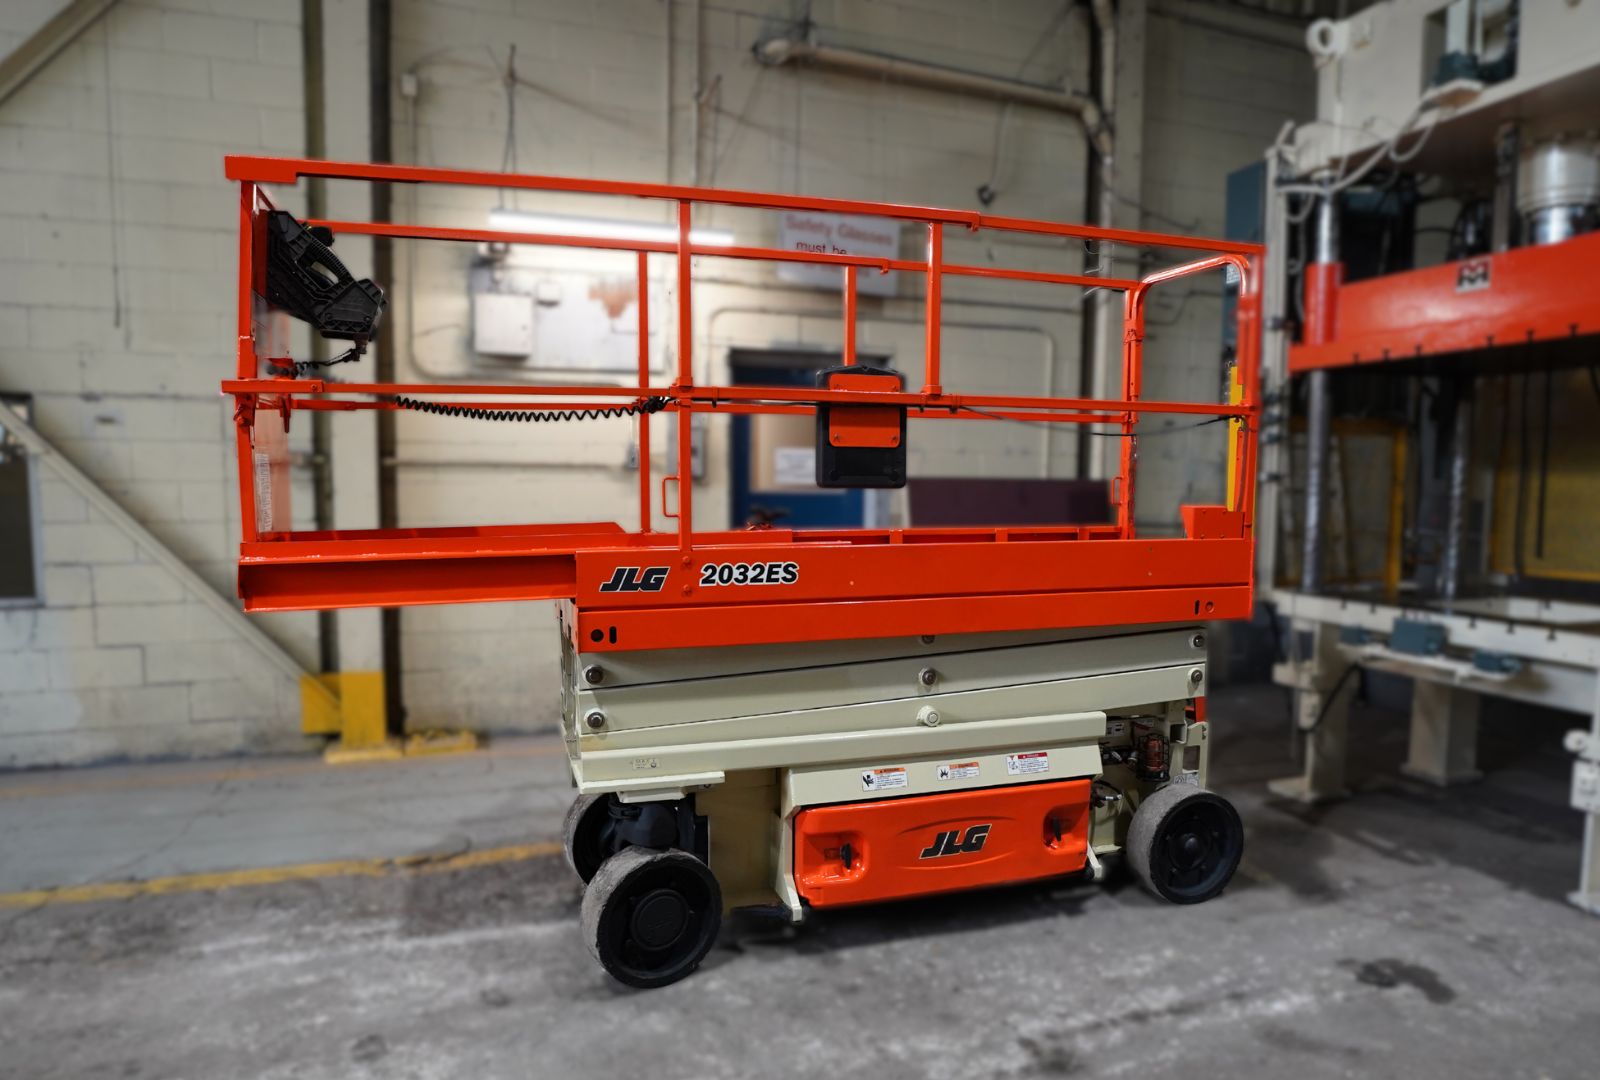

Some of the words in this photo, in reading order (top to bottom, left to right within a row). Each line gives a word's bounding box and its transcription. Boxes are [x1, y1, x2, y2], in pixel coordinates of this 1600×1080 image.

[784, 213, 832, 237] Safety
[838, 222, 893, 246] Glasses
[796, 241, 826, 253] must
[599, 566, 670, 592] JLG
[699, 561, 799, 586] 2032ES
[919, 823, 992, 859] JLG
